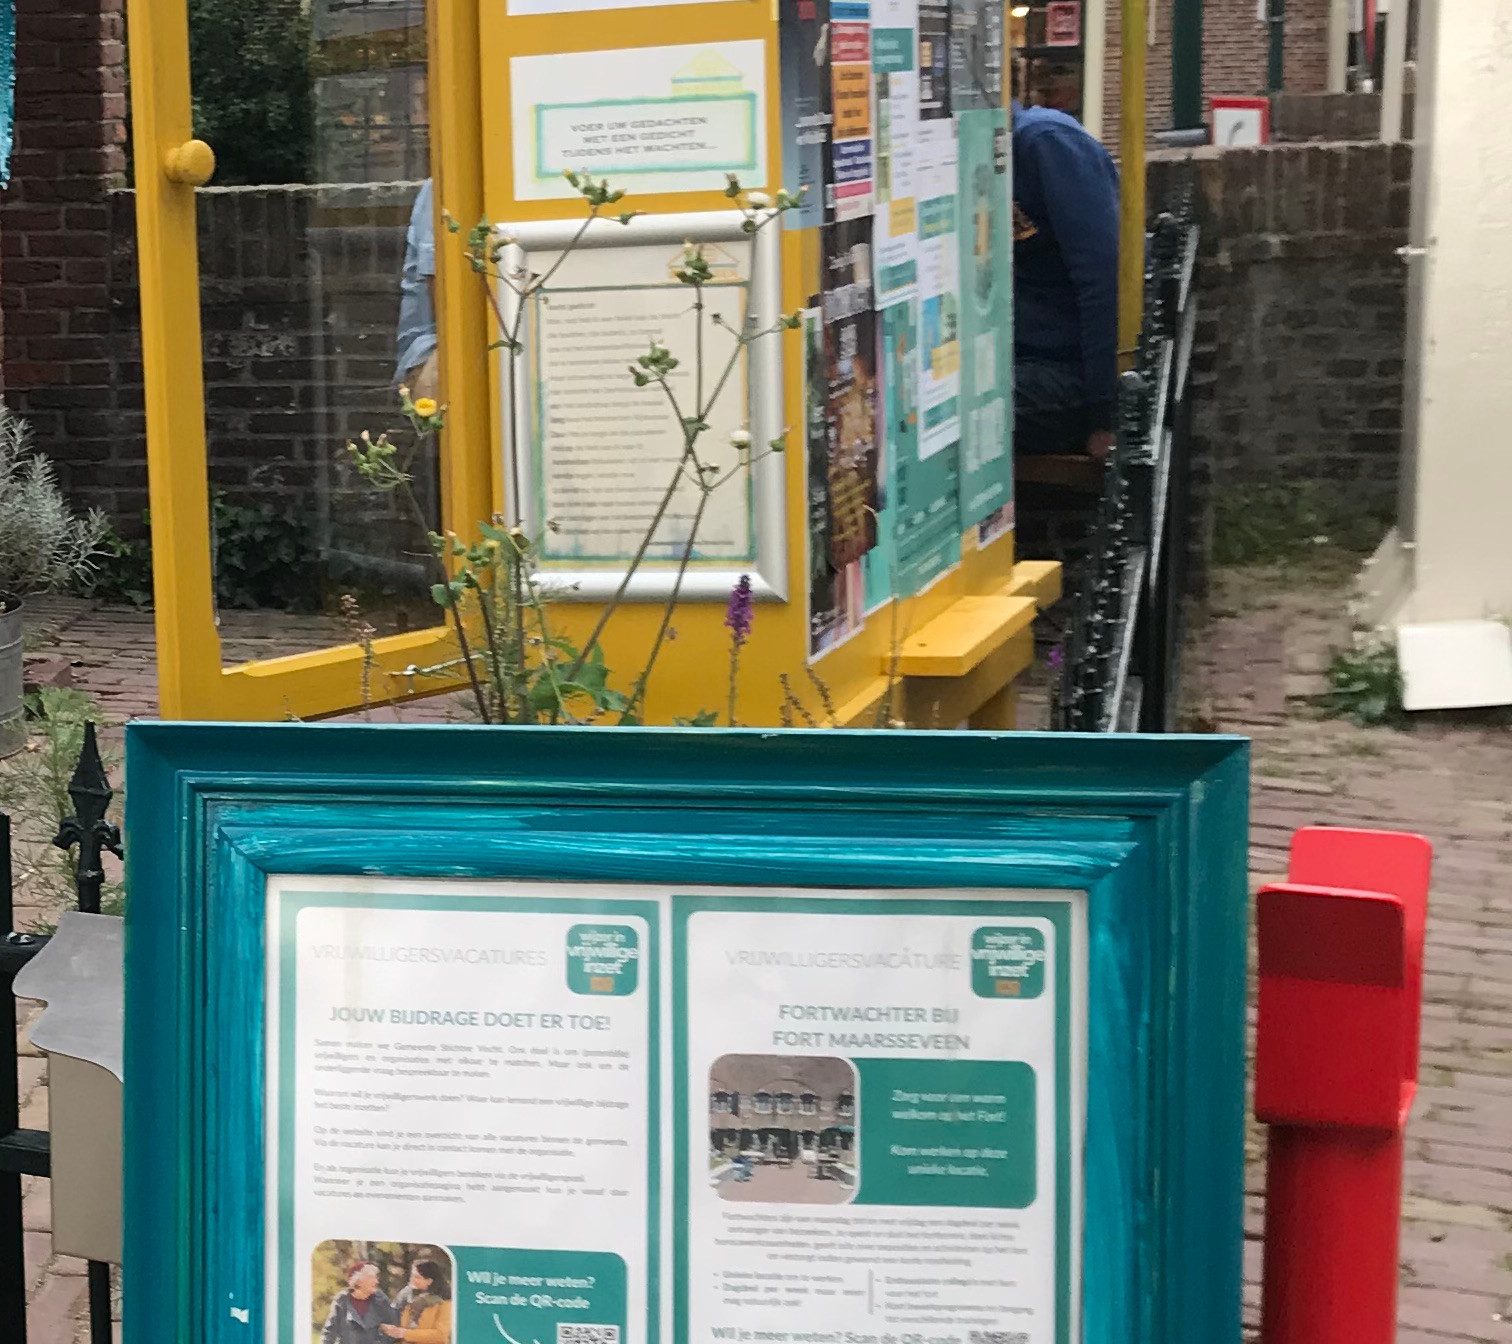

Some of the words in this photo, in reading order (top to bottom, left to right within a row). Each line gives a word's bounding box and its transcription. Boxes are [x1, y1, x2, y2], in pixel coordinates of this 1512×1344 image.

[329, 1006, 385, 1024] JOUW
[390, 1010, 478, 1027] BIJDRAGE
[483, 1012, 536, 1028] DOET
[540, 1014, 564, 1029] ER
[569, 1014, 611, 1031] TOE!
[778, 1004, 927, 1022] FORTWACHTER
[932, 1007, 959, 1023] BIJ
[772, 1030, 824, 1046] FORT
[828, 1032, 970, 1050] MAARSSEVEEN
[466, 1271, 491, 1284] Wil
[508, 1276, 543, 1286] meer
[475, 1291, 508, 1304] Scan
[509, 1293, 528, 1306] de
[529, 1294, 591, 1309] QR-code
